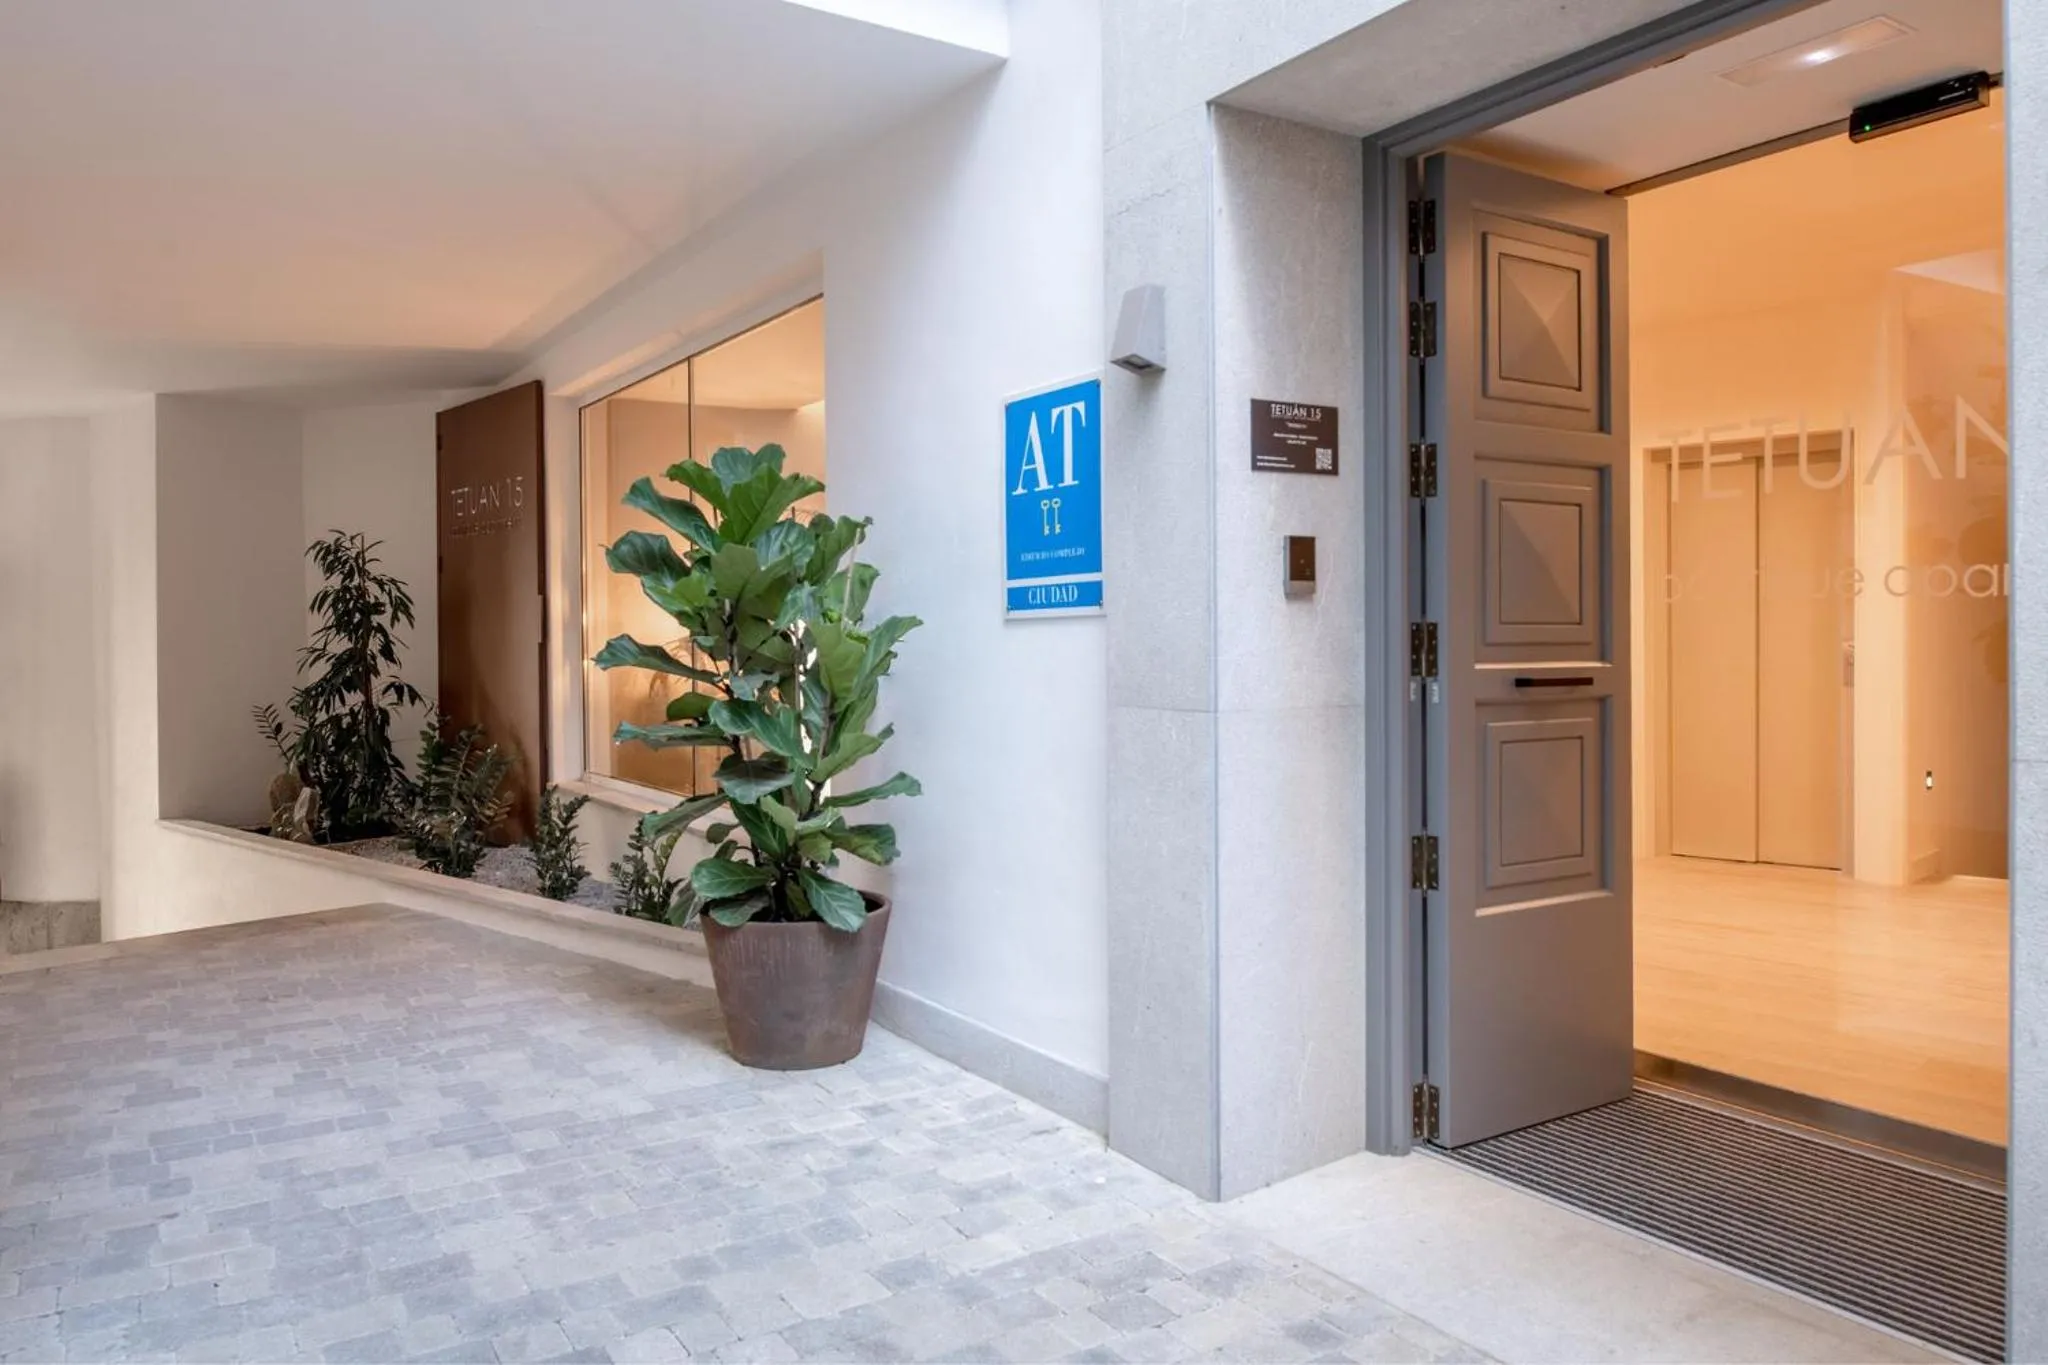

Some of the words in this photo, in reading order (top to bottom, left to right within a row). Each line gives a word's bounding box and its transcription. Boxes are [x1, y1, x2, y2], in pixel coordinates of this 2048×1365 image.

[1310, 408, 1322, 420] 15
[1012, 400, 1086, 495] AT
[506, 476, 523, 508] 15
[1028, 584, 1078, 604] CIUDAD
